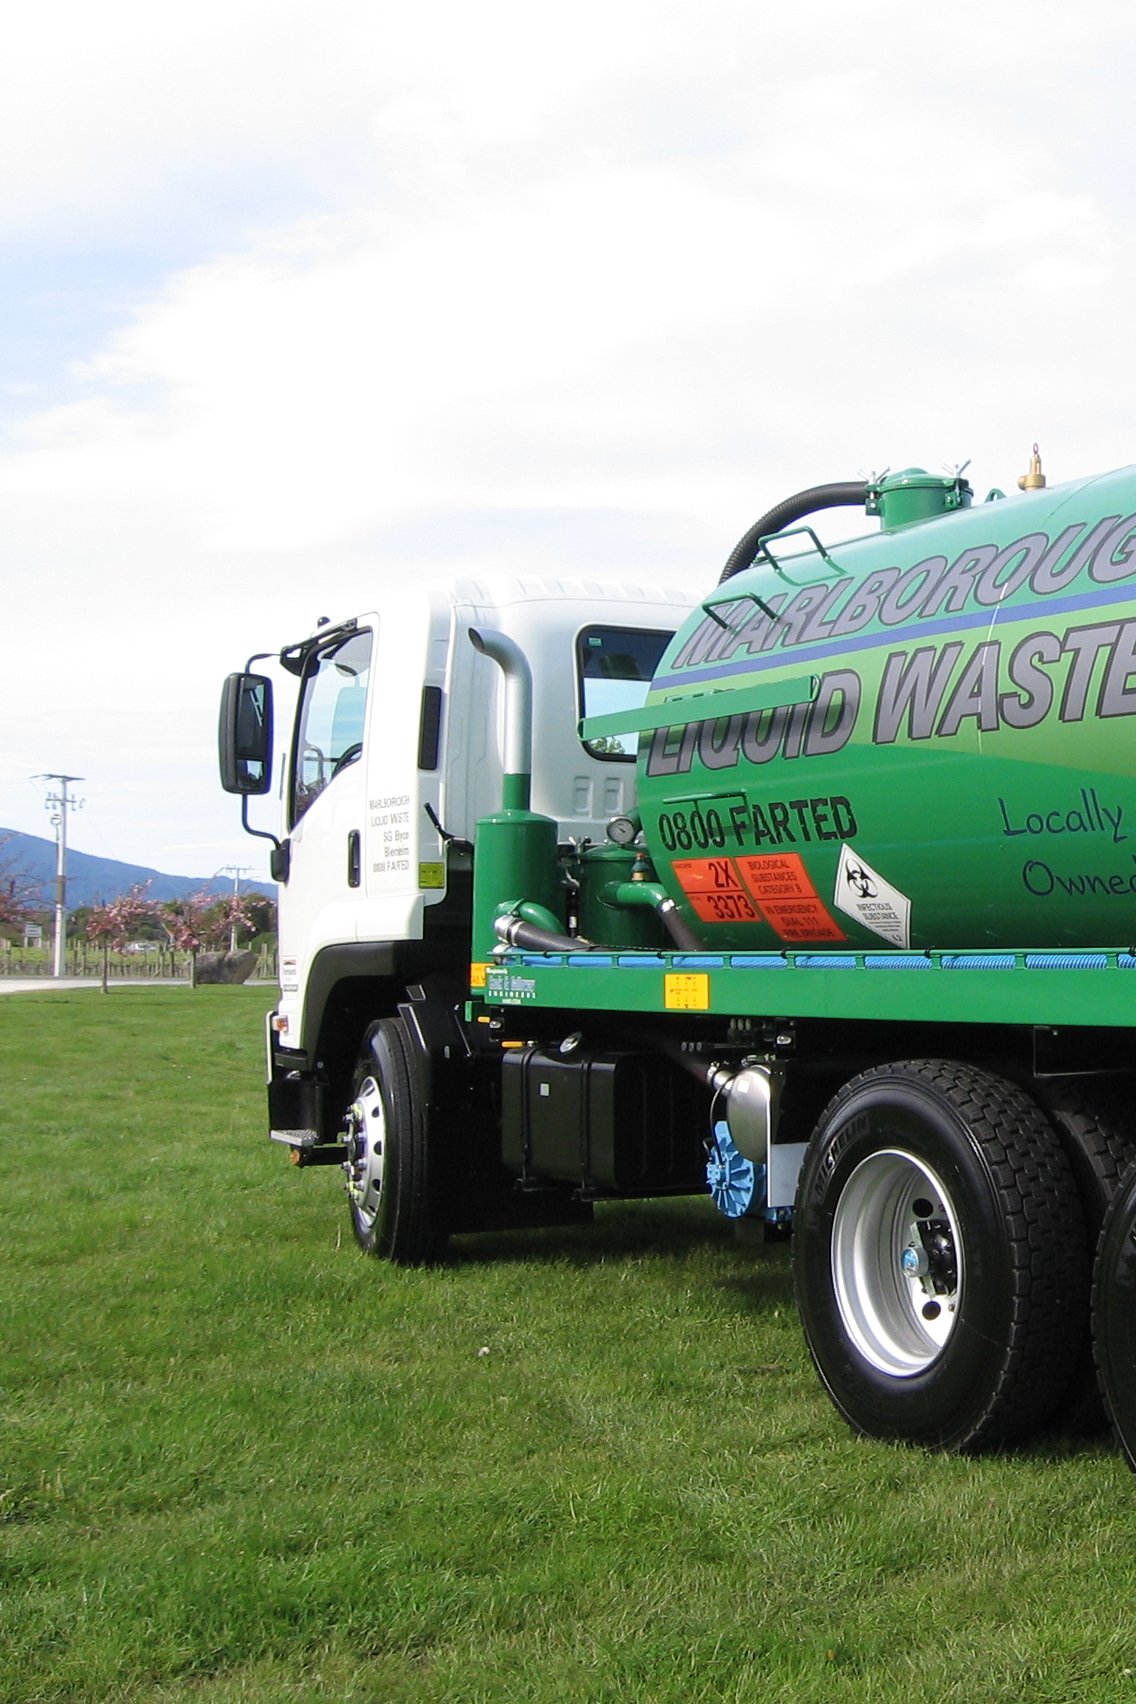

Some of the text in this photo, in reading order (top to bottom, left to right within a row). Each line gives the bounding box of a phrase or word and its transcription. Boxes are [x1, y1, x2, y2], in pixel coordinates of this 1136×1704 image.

[658, 796, 858, 851] 0800 FARTED
[998, 787, 1128, 844] Locally
[708, 860, 739, 888] 2X
[707, 895, 756, 919] 3373
